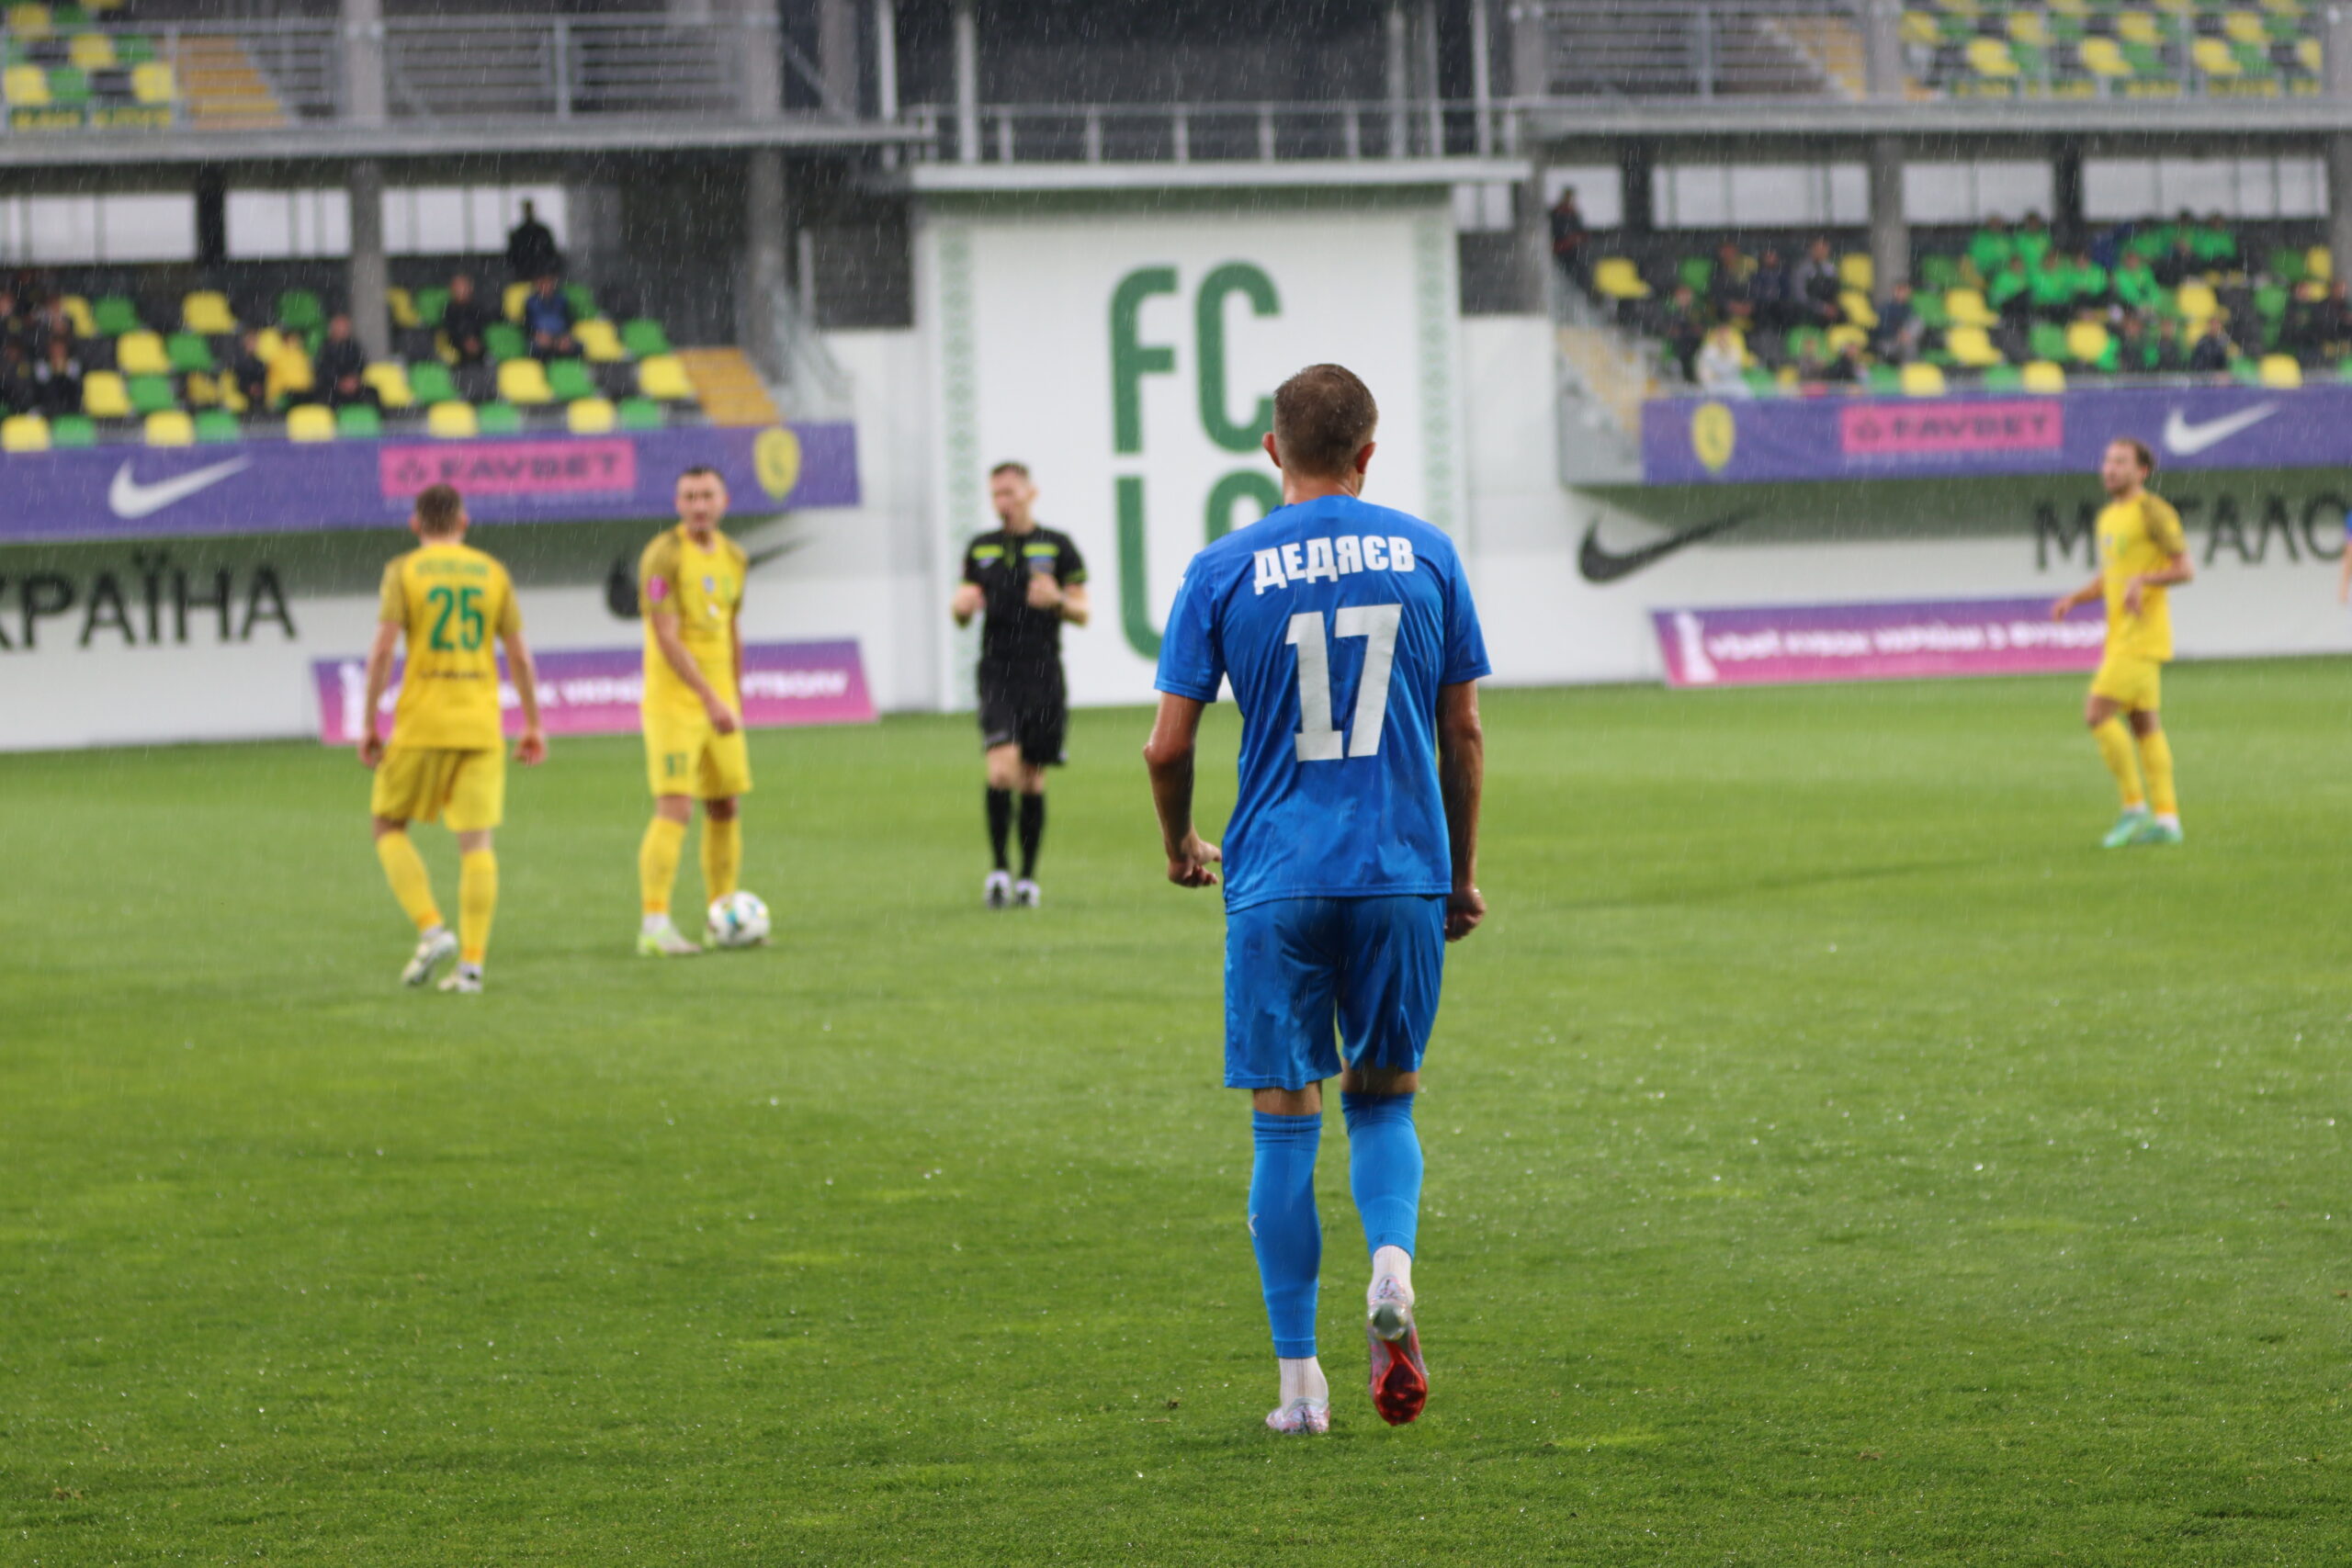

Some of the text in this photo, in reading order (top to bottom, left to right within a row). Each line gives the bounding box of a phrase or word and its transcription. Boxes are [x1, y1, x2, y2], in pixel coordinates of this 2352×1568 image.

[1110, 260, 1282, 454] FC
[427, 585, 485, 652] 25
[1253, 535, 1416, 595] ДЕДЯЄВ
[1285, 604, 1404, 762] 17
